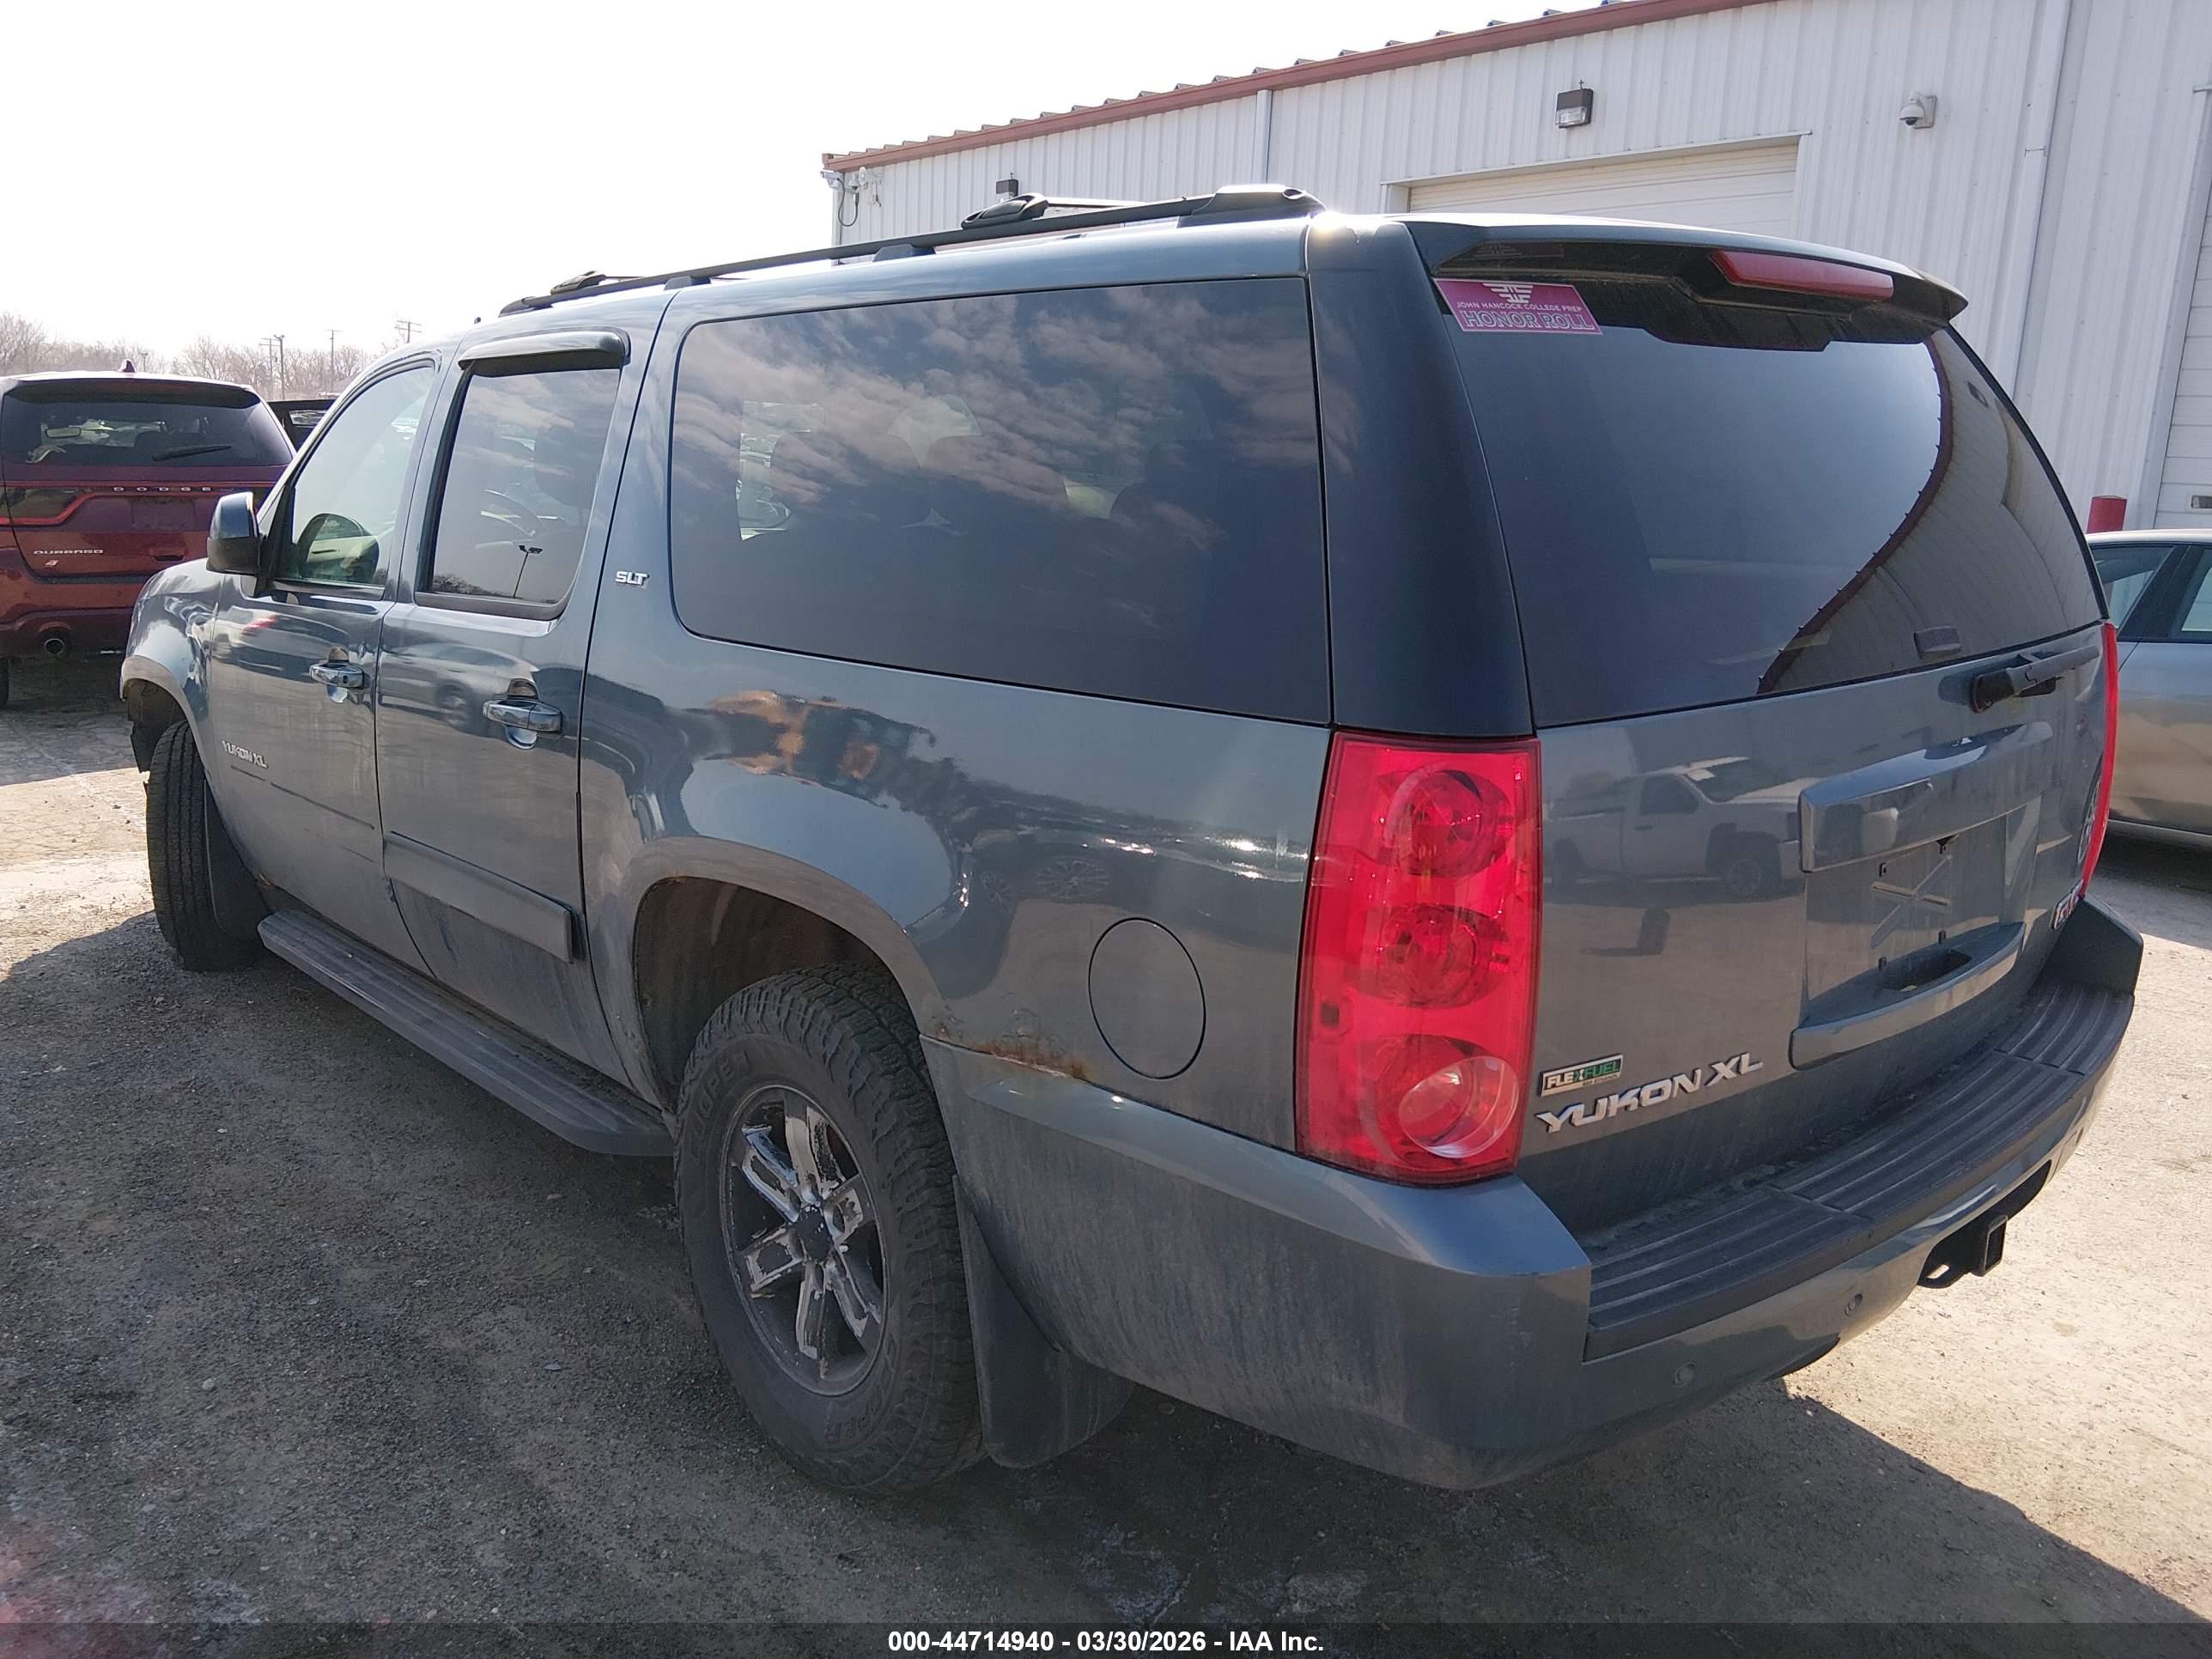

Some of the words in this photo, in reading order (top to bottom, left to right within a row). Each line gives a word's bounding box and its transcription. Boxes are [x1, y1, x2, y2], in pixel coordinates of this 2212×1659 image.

[1524, 303, 1560, 312] COLLEGE
[1461, 310, 1540, 328] HONOR
[1540, 313, 1595, 331] ROLL
[615, 570, 648, 586] SLT
[221, 739, 253, 763] YUKON
[252, 752, 269, 769] XL
[1534, 1068, 1703, 1134] YUKON
[1705, 1053, 1765, 1087] XL
